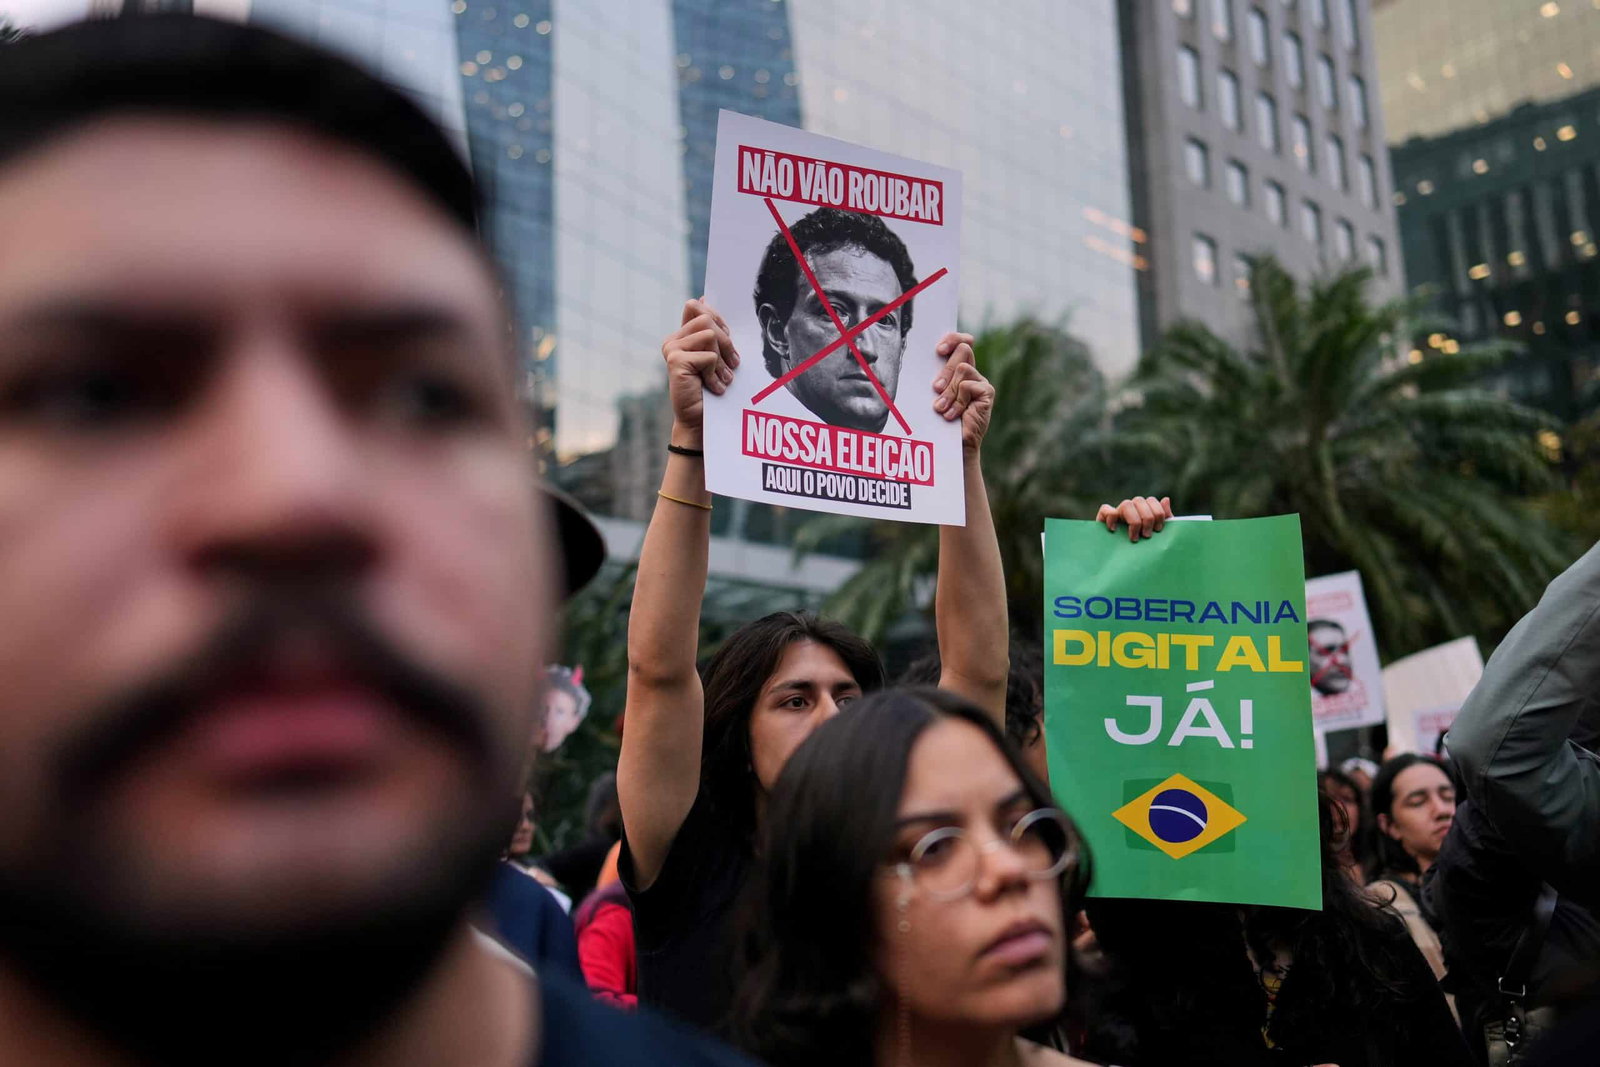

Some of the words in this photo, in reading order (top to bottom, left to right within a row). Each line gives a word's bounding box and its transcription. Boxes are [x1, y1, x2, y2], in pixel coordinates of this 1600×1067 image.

[742, 151, 794, 197] NÃO
[797, 161, 844, 206] VÃO
[849, 169, 940, 223] ROUBAR
[746, 414, 832, 466] NOSSA
[836, 430, 931, 482] ELEIÇÃO
[765, 466, 801, 492] AQUI
[803, 469, 814, 495] O
[816, 472, 856, 501] POVO
[858, 477, 909, 507] DECIDE
[1053, 596, 1299, 625] SOBERANIA
[1053, 629, 1303, 672] DIGITAL
[1104, 679, 1254, 749] JÁ!
